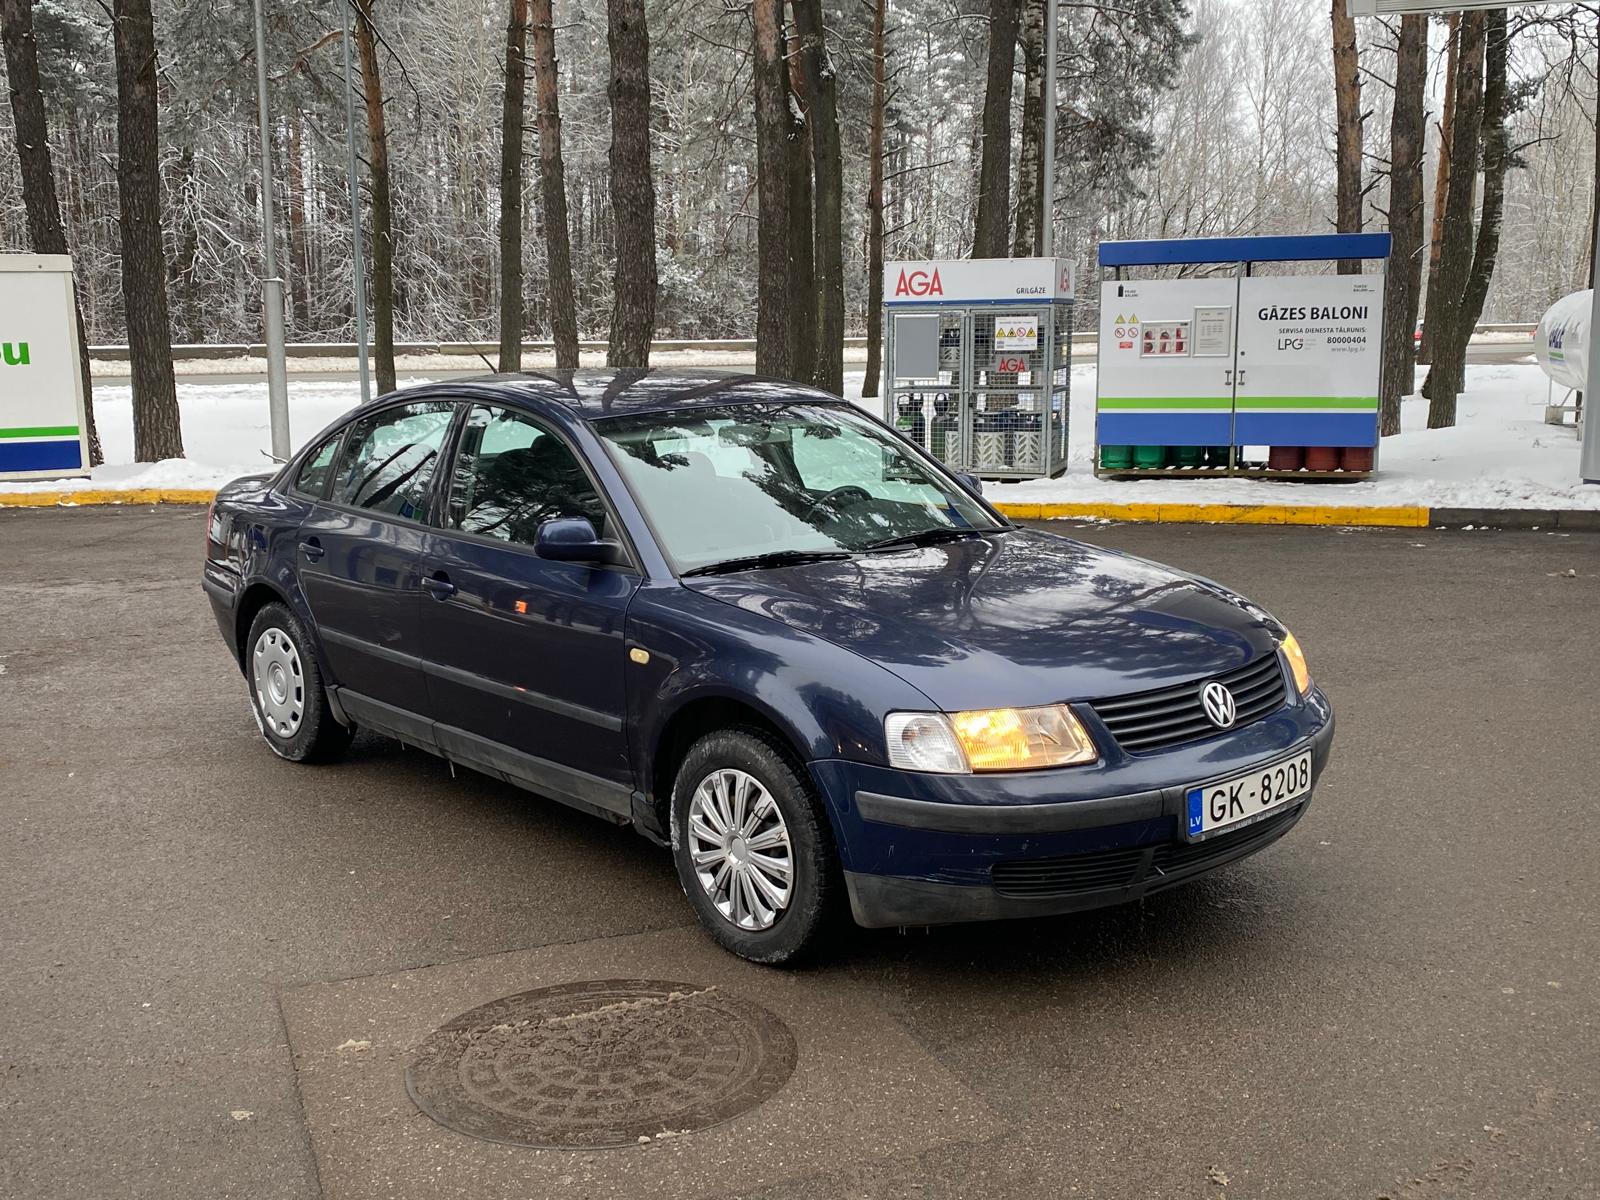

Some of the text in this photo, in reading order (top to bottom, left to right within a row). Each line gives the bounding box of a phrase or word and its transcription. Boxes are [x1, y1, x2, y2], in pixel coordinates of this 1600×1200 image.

[895, 266, 943, 296] AGA
[1258, 305, 1368, 321] GĀZES BALONI
[1277, 338, 1303, 351] LPG
[1326, 336, 1367, 344] 80000404
[0, 342, 30, 366] u
[998, 356, 1025, 372] AGA
[1210, 758, 1308, 822] GK-8208
[1190, 816, 1202, 827] LV
